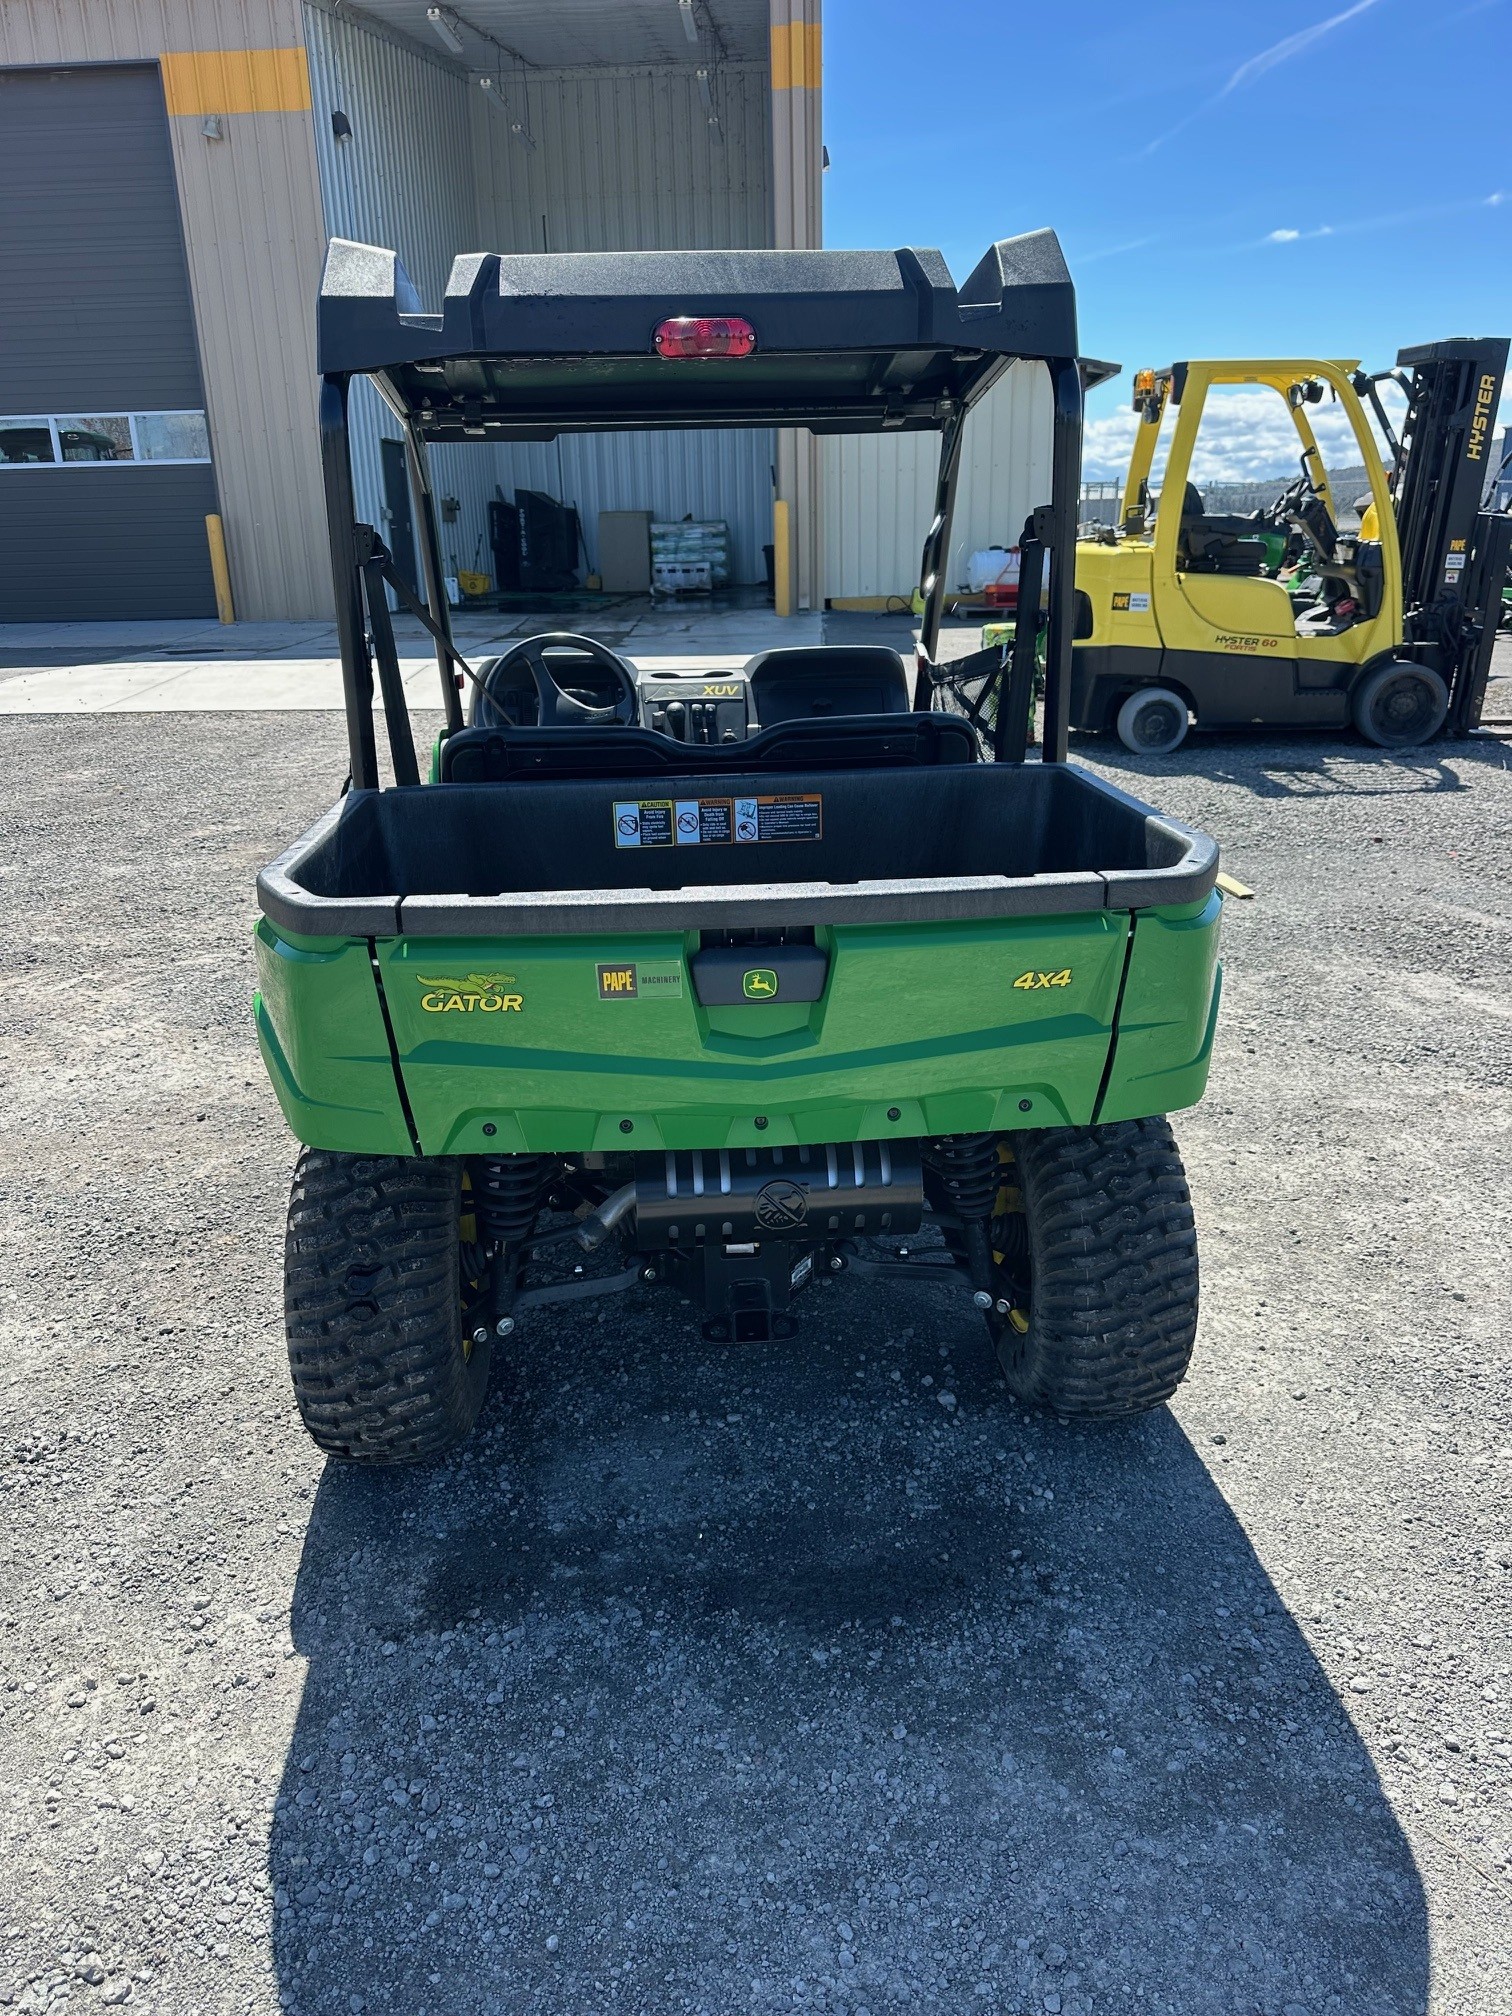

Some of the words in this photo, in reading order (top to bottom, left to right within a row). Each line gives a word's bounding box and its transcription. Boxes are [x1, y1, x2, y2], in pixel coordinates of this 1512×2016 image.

[1467, 374, 1495, 460] HYSTER
[1215, 635, 1259, 646] HYSTER
[1262, 639, 1278, 648] 60
[1224, 644, 1257, 652] FORTIS
[703, 685, 739, 696] XUV
[641, 974, 681, 985] MACHINERY
[420, 993, 524, 1013] GATOR
